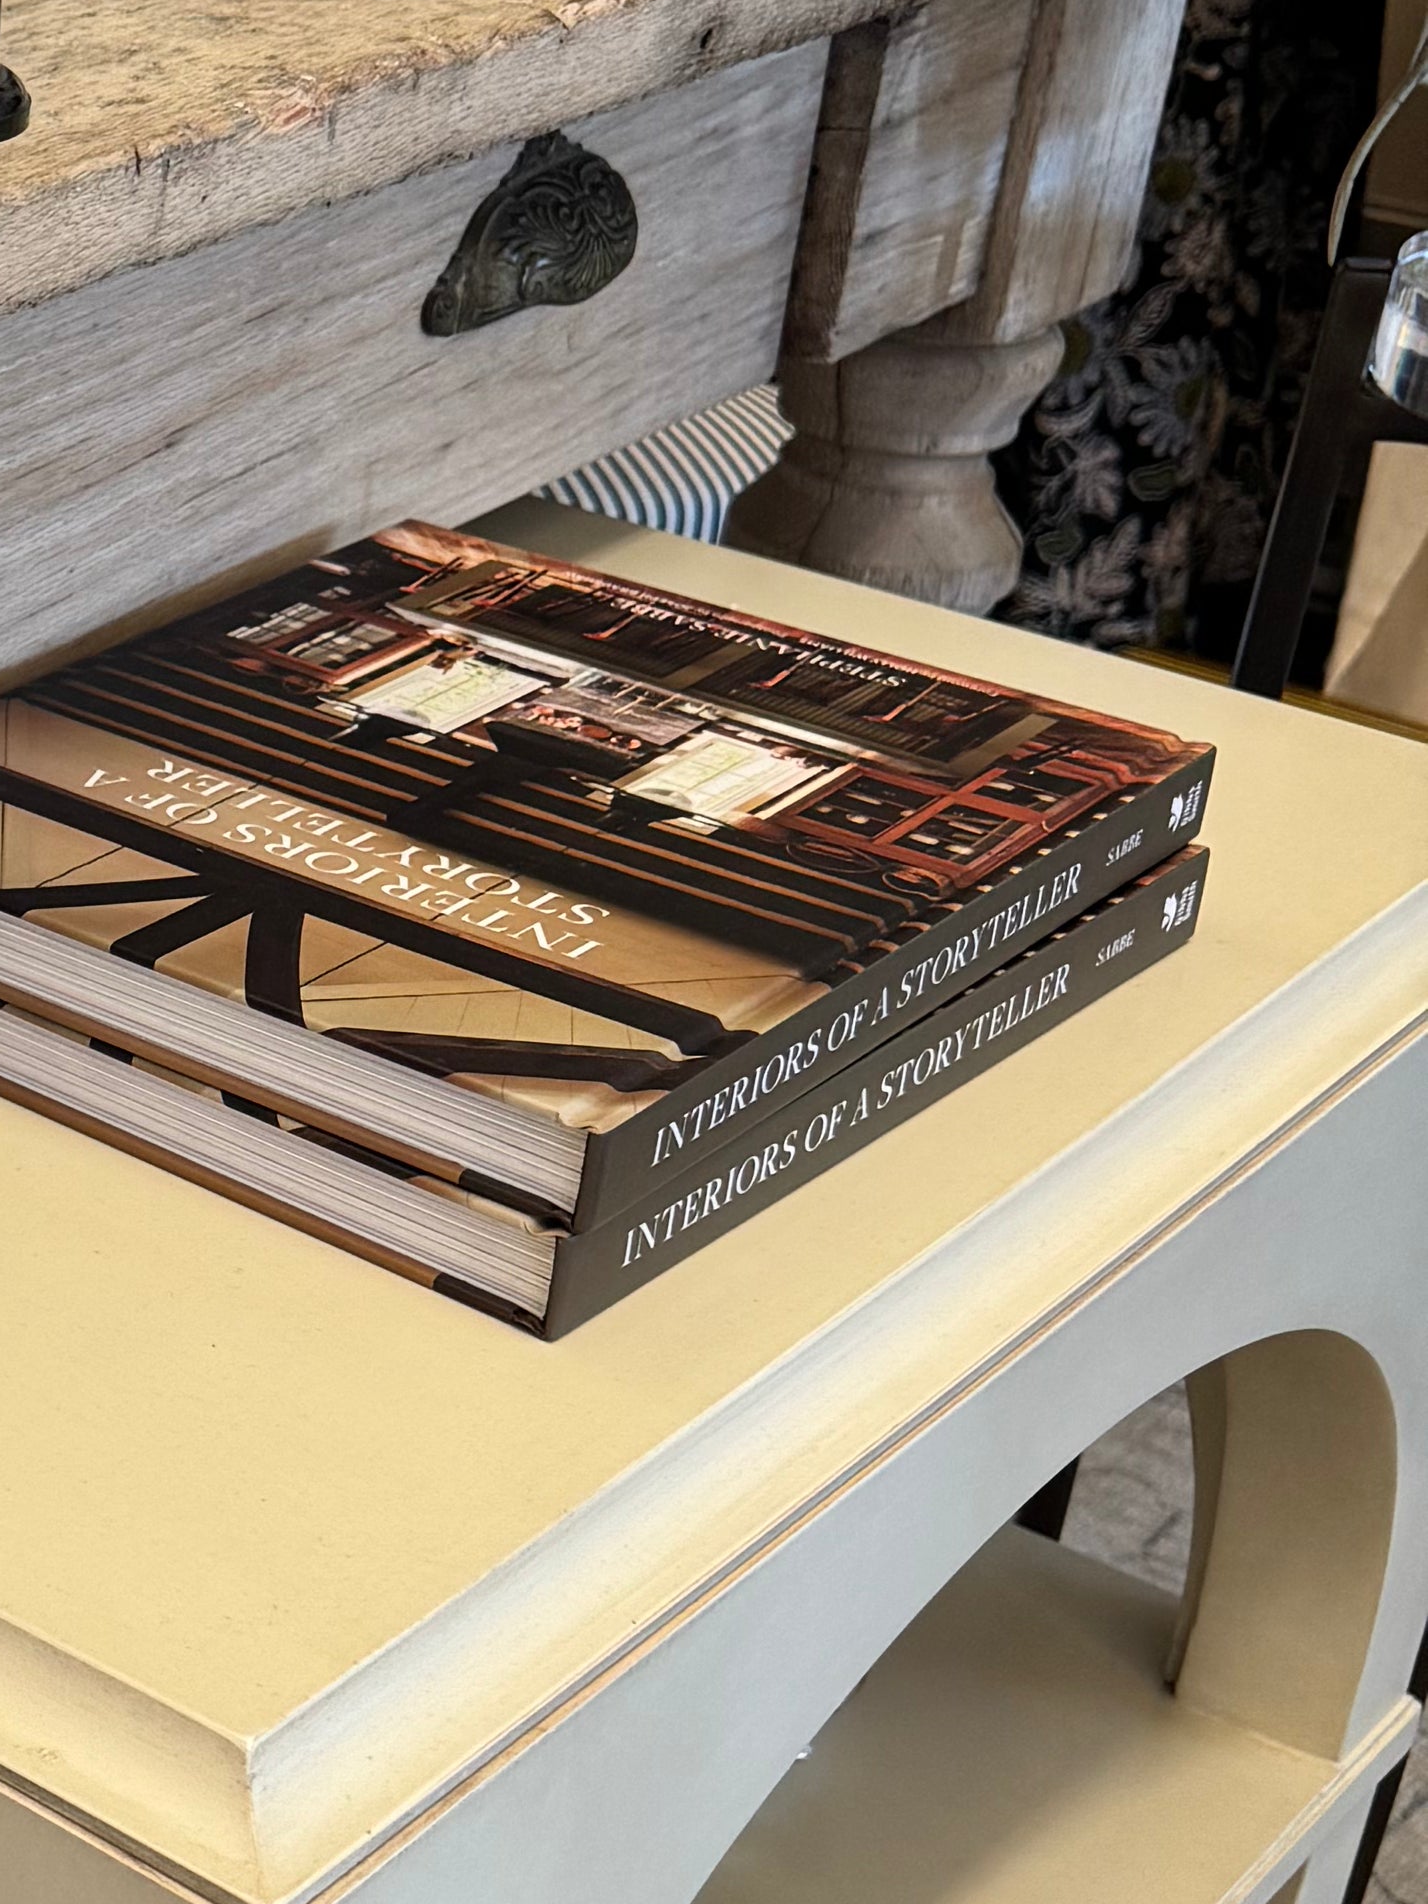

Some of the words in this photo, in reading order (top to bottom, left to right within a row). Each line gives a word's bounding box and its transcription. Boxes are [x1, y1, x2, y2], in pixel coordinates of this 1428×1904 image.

[83, 768, 131, 789] A
[123, 793, 219, 826] OF
[145, 758, 611, 926] STORYTELLER
[1105, 828, 1144, 866] SABBE
[222, 822, 605, 960] INTERIORS
[1095, 928, 1136, 966] SABBE
[650, 1028, 822, 1169] INTERIORS
[827, 998, 868, 1052] OF
[870, 985, 890, 1026] A
[895, 862, 1082, 1010] STORYTELLER
[620, 1129, 798, 1269] INTERIORS
[803, 1100, 847, 1153] OF
[849, 1086, 870, 1127] A
[876, 963, 1071, 1110] STORYTELLER
